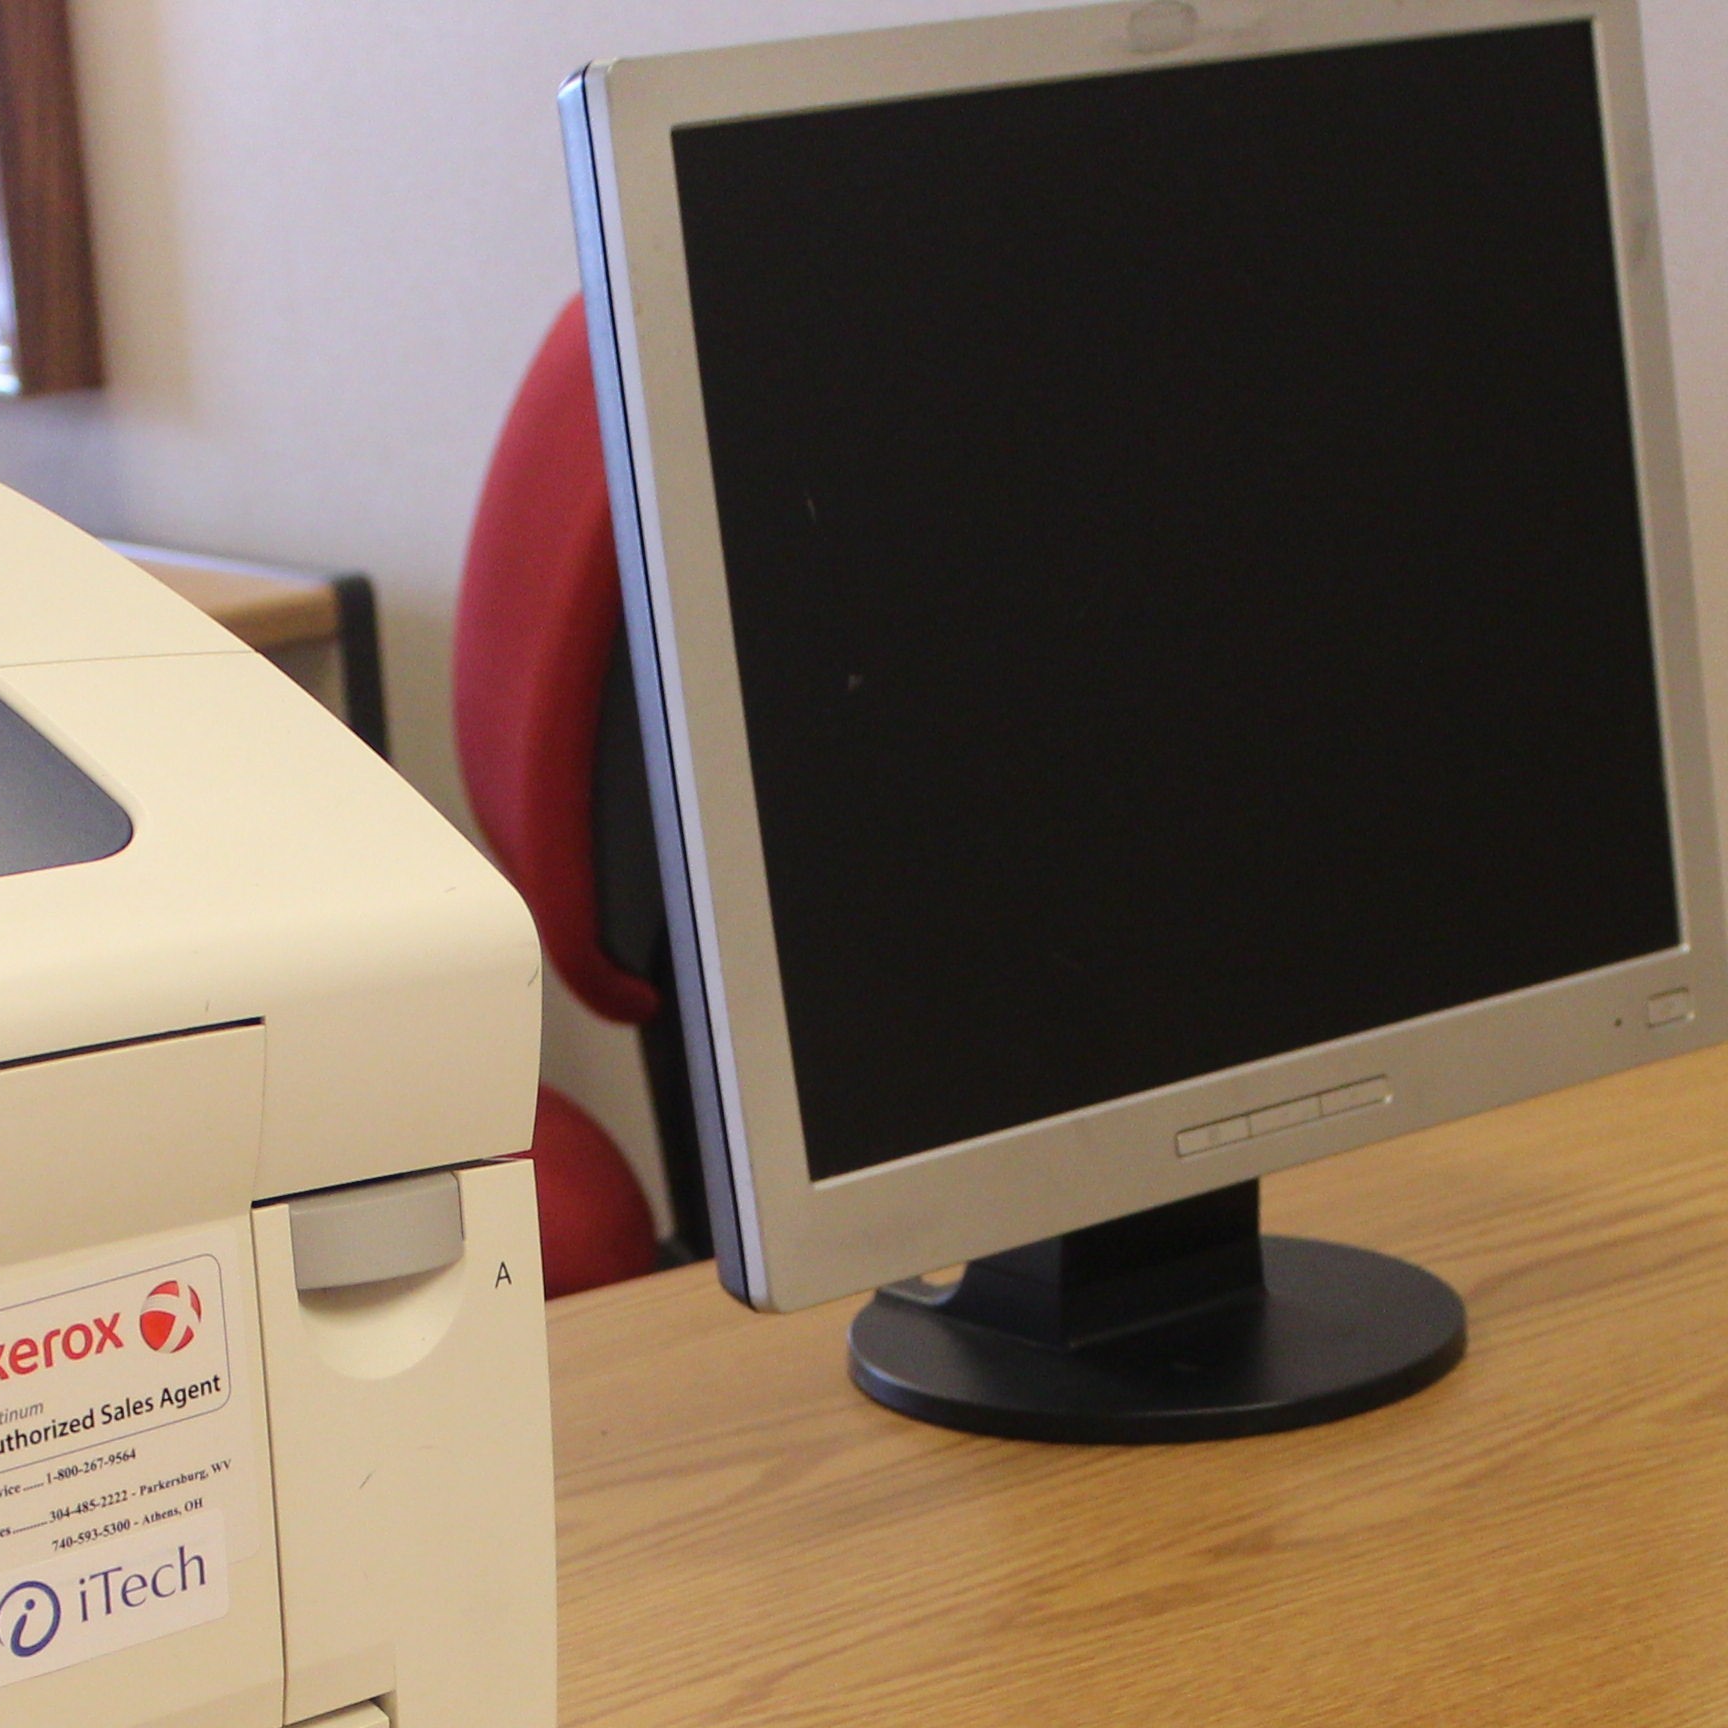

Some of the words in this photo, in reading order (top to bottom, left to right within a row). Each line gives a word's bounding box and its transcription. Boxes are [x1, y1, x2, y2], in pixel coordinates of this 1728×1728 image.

[495, 1261, 512, 1289] A
[101, 1396, 154, 1425] Sales
[160, 1374, 221, 1409] Agent
[46, 1448, 136, 1484] 1-800-267-9564
[139, 1469, 209, 1496] Parkersburg,
[211, 1459, 232, 1474] WV
[142, 1506, 182, 1526] Athens,
[184, 1497, 203, 1513] OH
[78, 1544, 207, 1623] iTech
